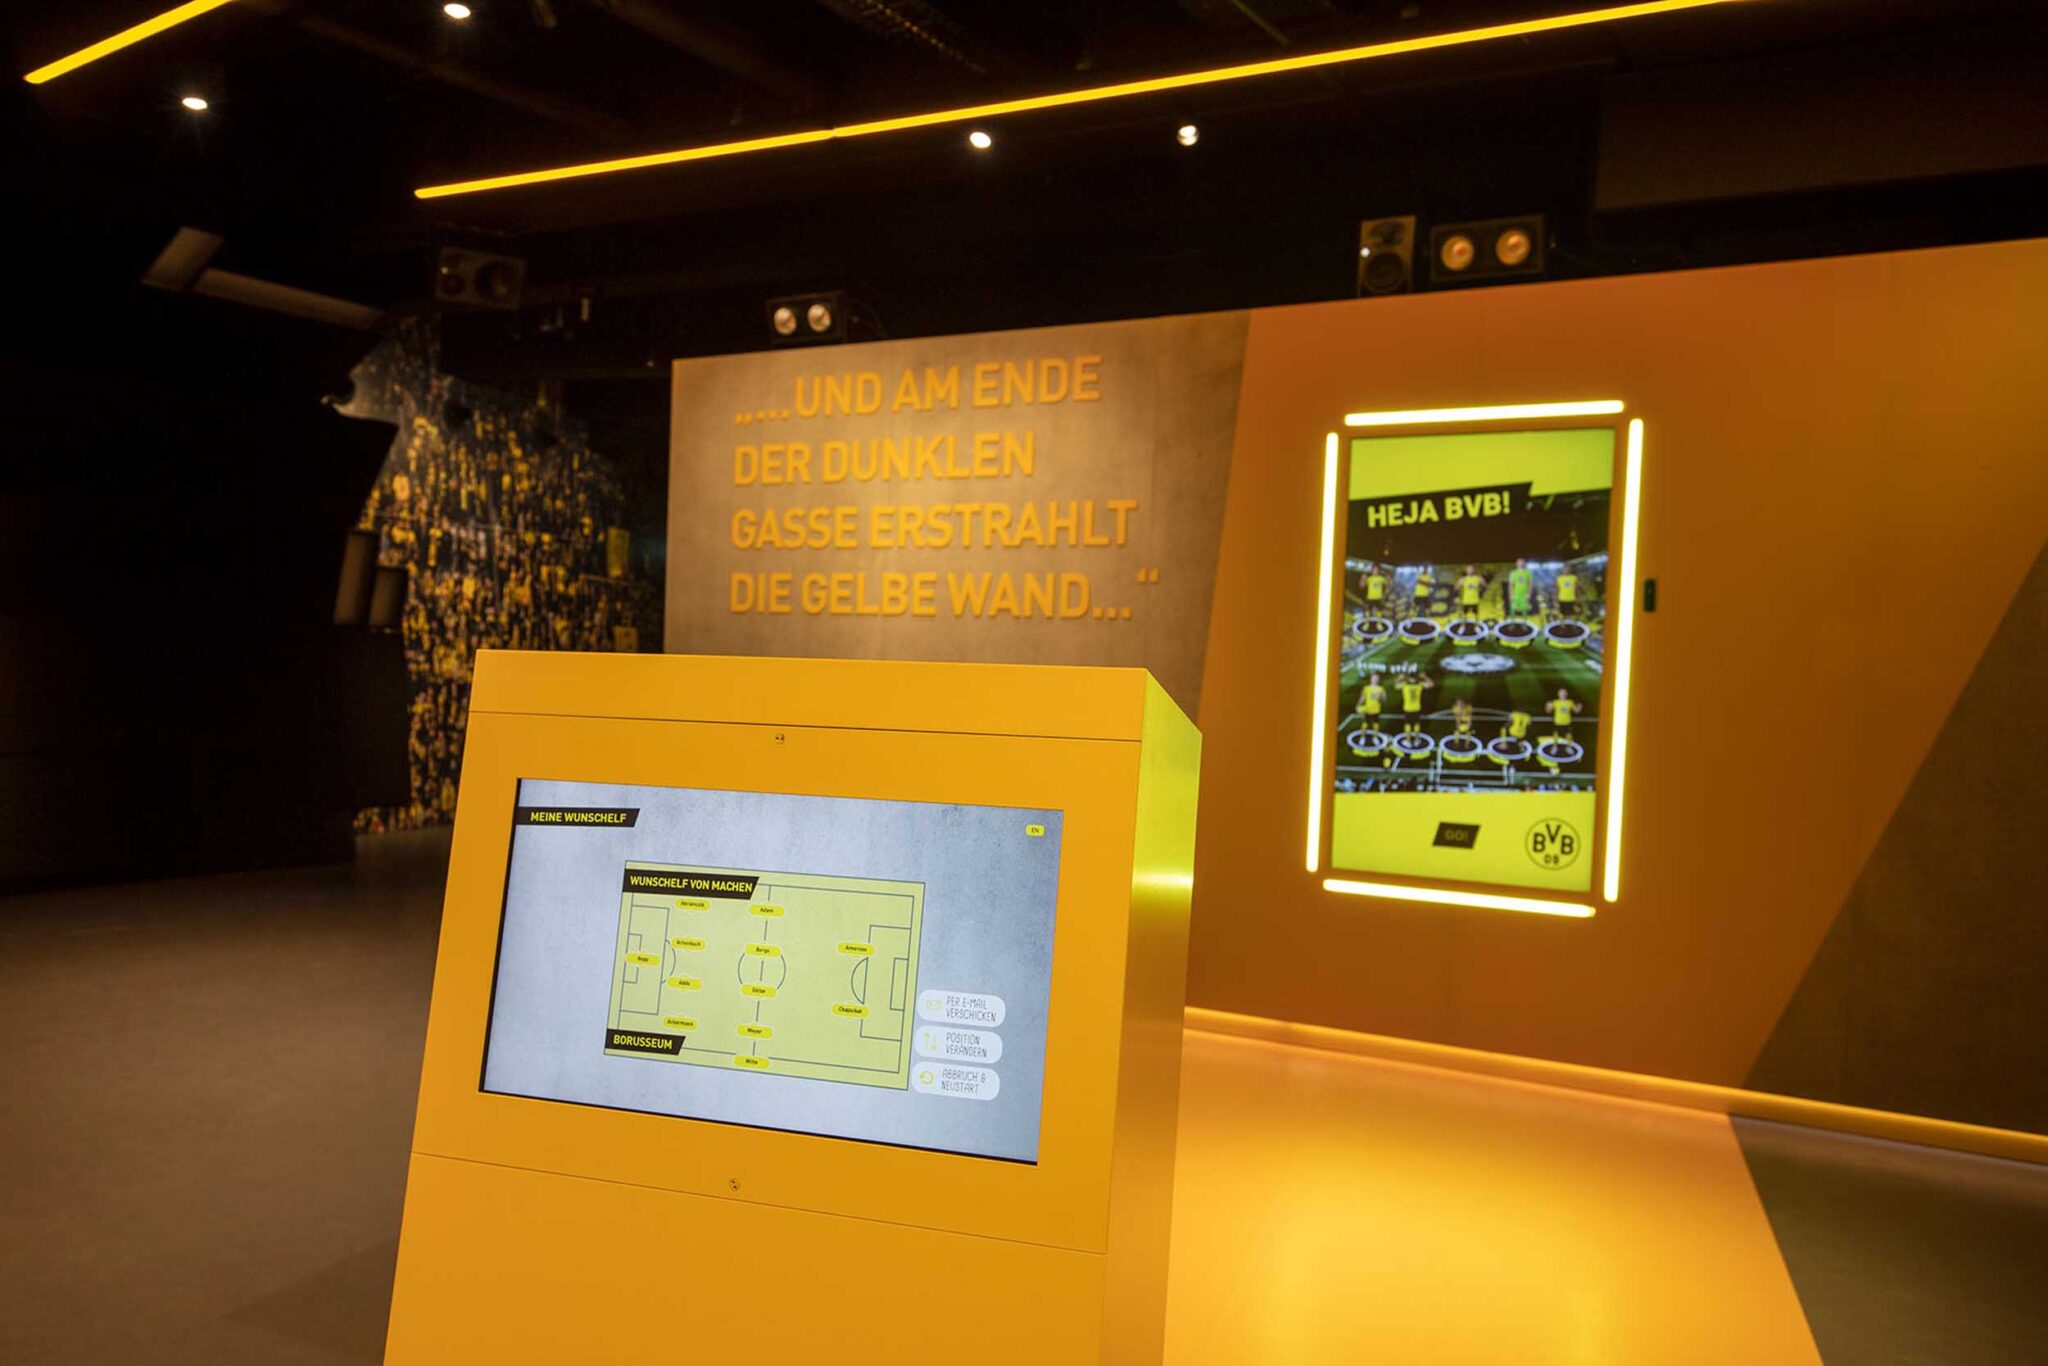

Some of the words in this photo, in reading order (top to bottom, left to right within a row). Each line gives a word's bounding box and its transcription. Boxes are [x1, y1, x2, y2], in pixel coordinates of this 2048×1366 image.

[892, 365, 962, 412] AM
[972, 355, 1102, 408] ENDE
[733, 442, 812, 486] DER
[821, 431, 1036, 483] DUNKLEN
[1367, 499, 1440, 528] HEJA
[1445, 490, 1511, 520] BVB!
[730, 506, 860, 549] GASSE
[869, 499, 1138, 549] ERSTRAHLT
[729, 572, 793, 615] DIE
[801, 571, 939, 618] GELBE
[530, 811, 563, 823] MEINE
[564, 812, 628, 824] WUNSCHELF
[1031, 826, 1040, 834] EN
[1532, 823, 1575, 856] BVB
[629, 875, 689, 890] WUNSCHELF
[690, 879, 711, 891] VON
[711, 881, 753, 894] MACHEN
[946, 995, 960, 1007] PER
[962, 997, 988, 1010] E-MAIL
[946, 1007, 997, 1022] VERSCHICKEN
[613, 1034, 673, 1050] BORUSSEUM
[946, 1032, 981, 1046] POSITION
[942, 1068, 978, 1082] ABBRUCH
[941, 1080, 979, 1094] NEUSTART
